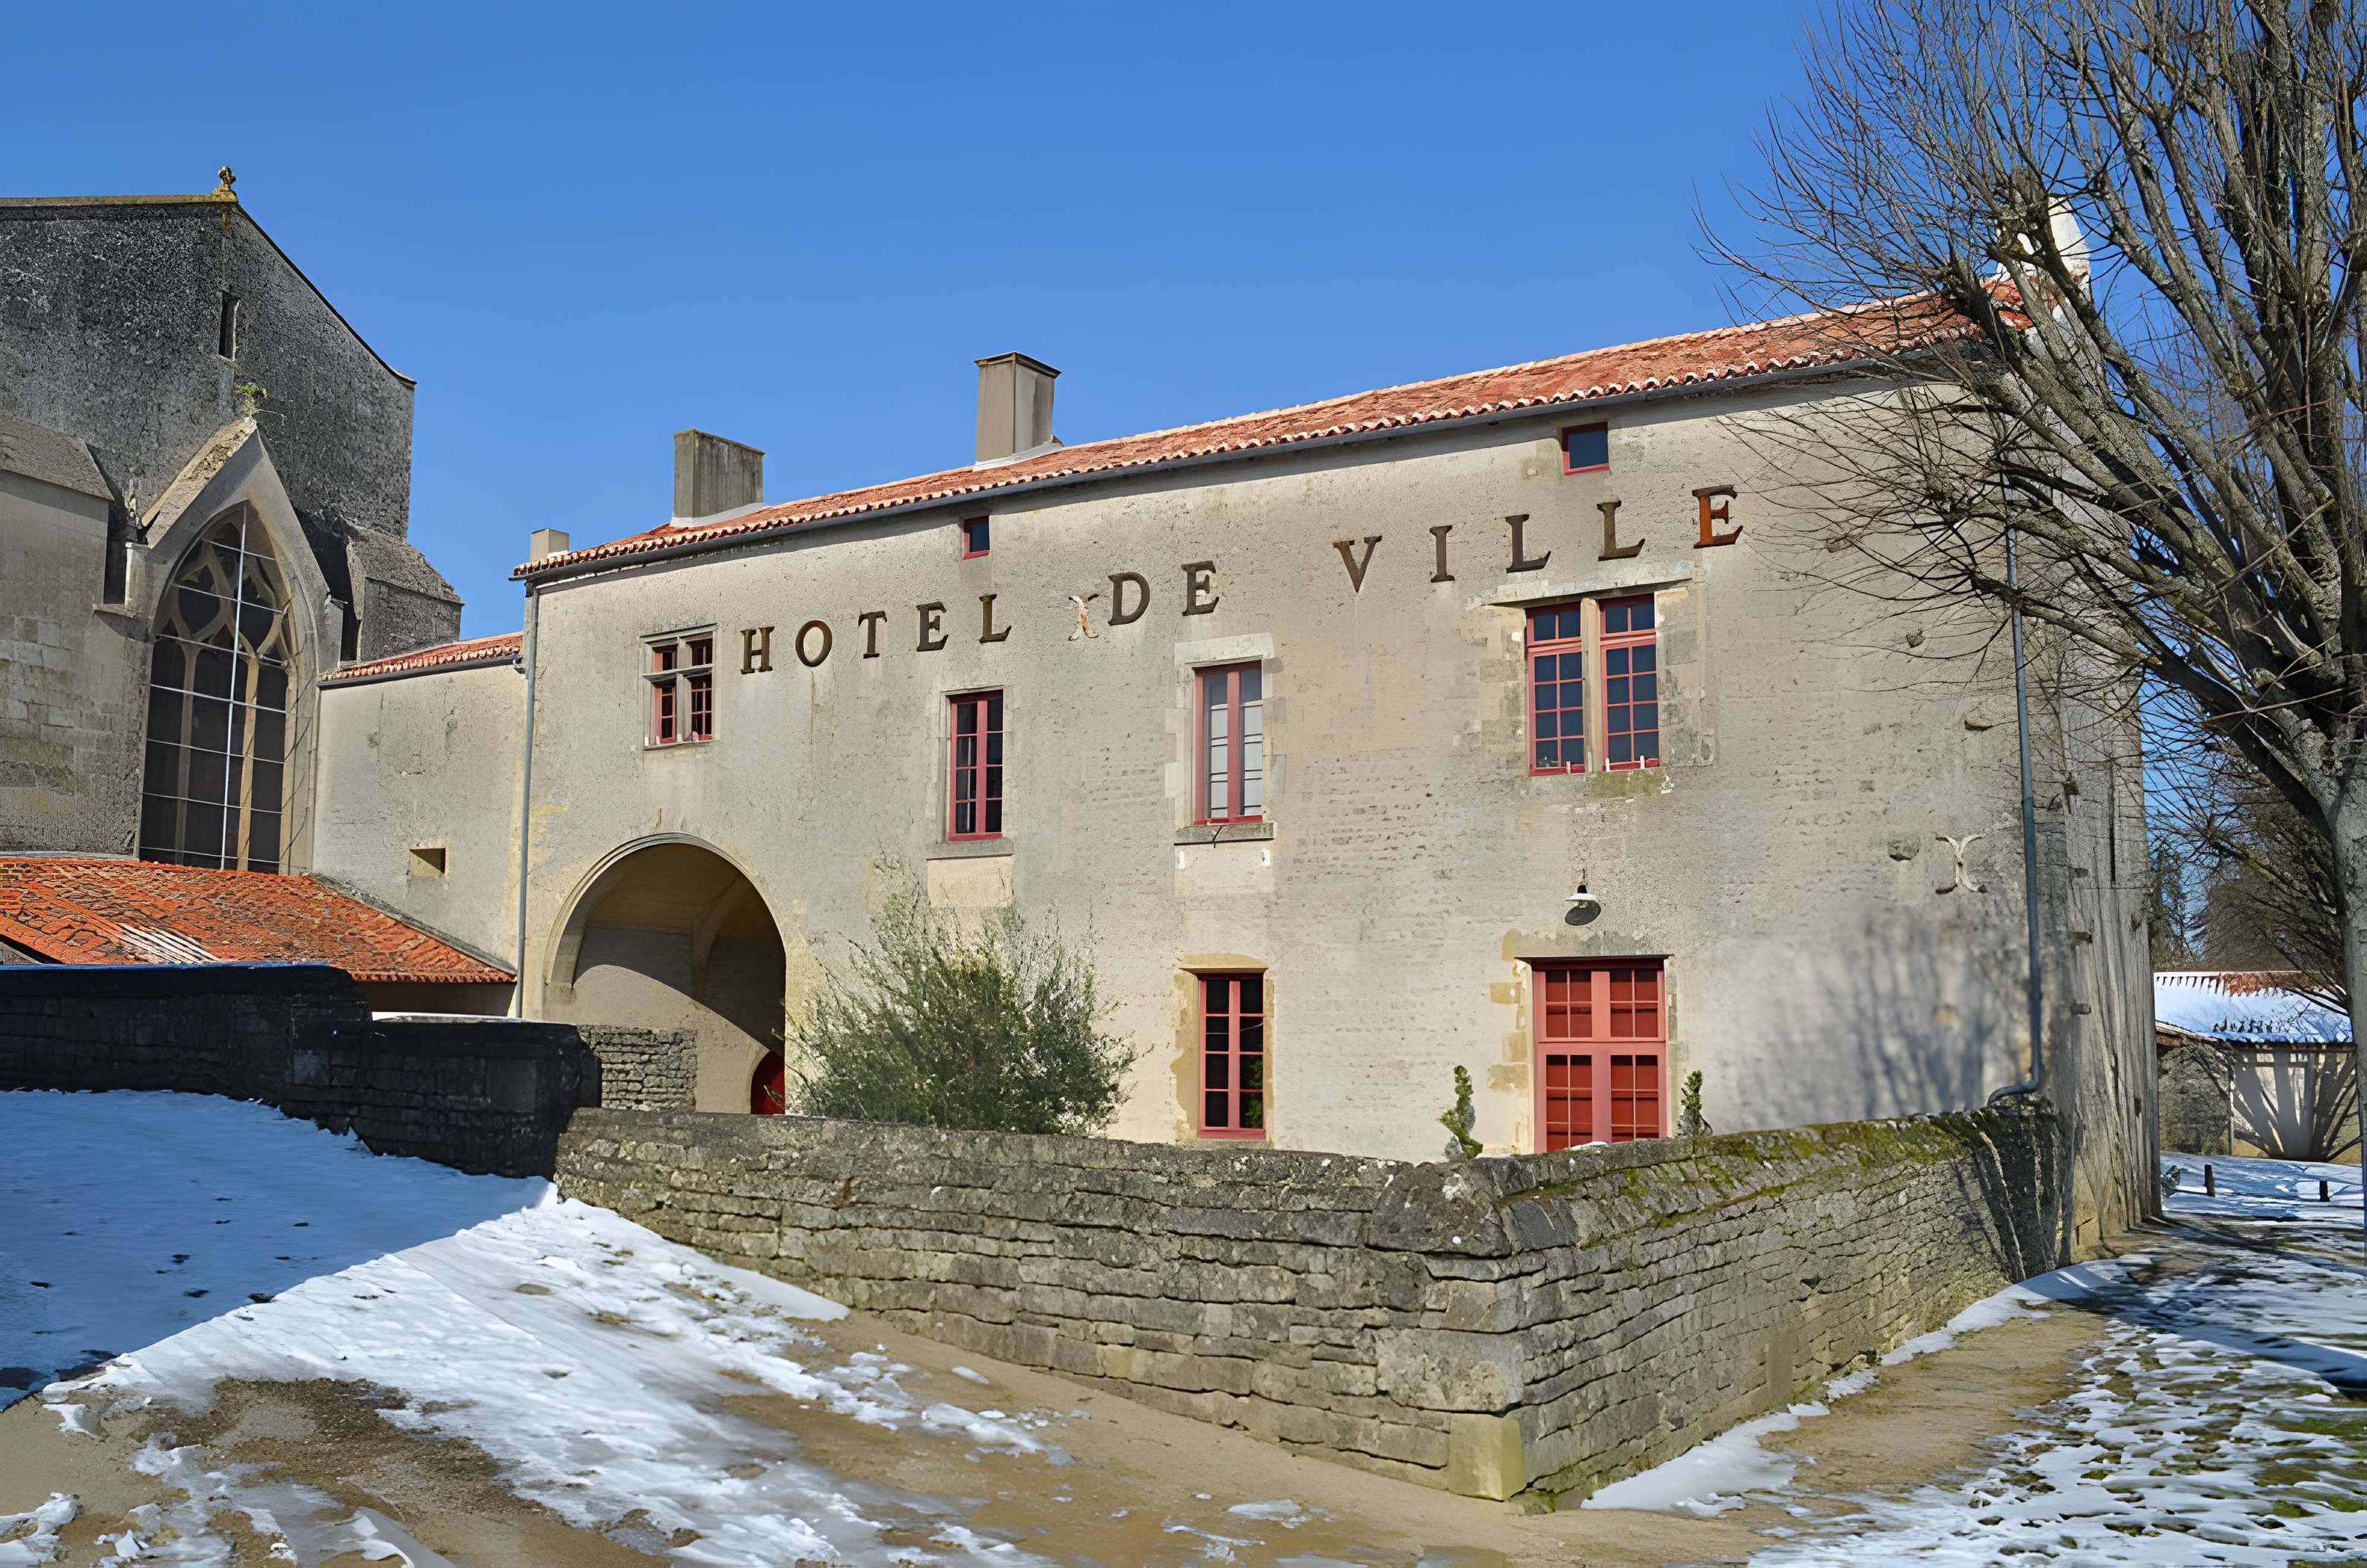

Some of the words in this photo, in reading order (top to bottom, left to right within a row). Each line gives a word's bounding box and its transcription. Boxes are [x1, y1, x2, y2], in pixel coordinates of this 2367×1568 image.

[740, 594, 1012, 675] HOTEL
[1107, 561, 1220, 626] DE
[1332, 484, 1743, 593] VILLE
